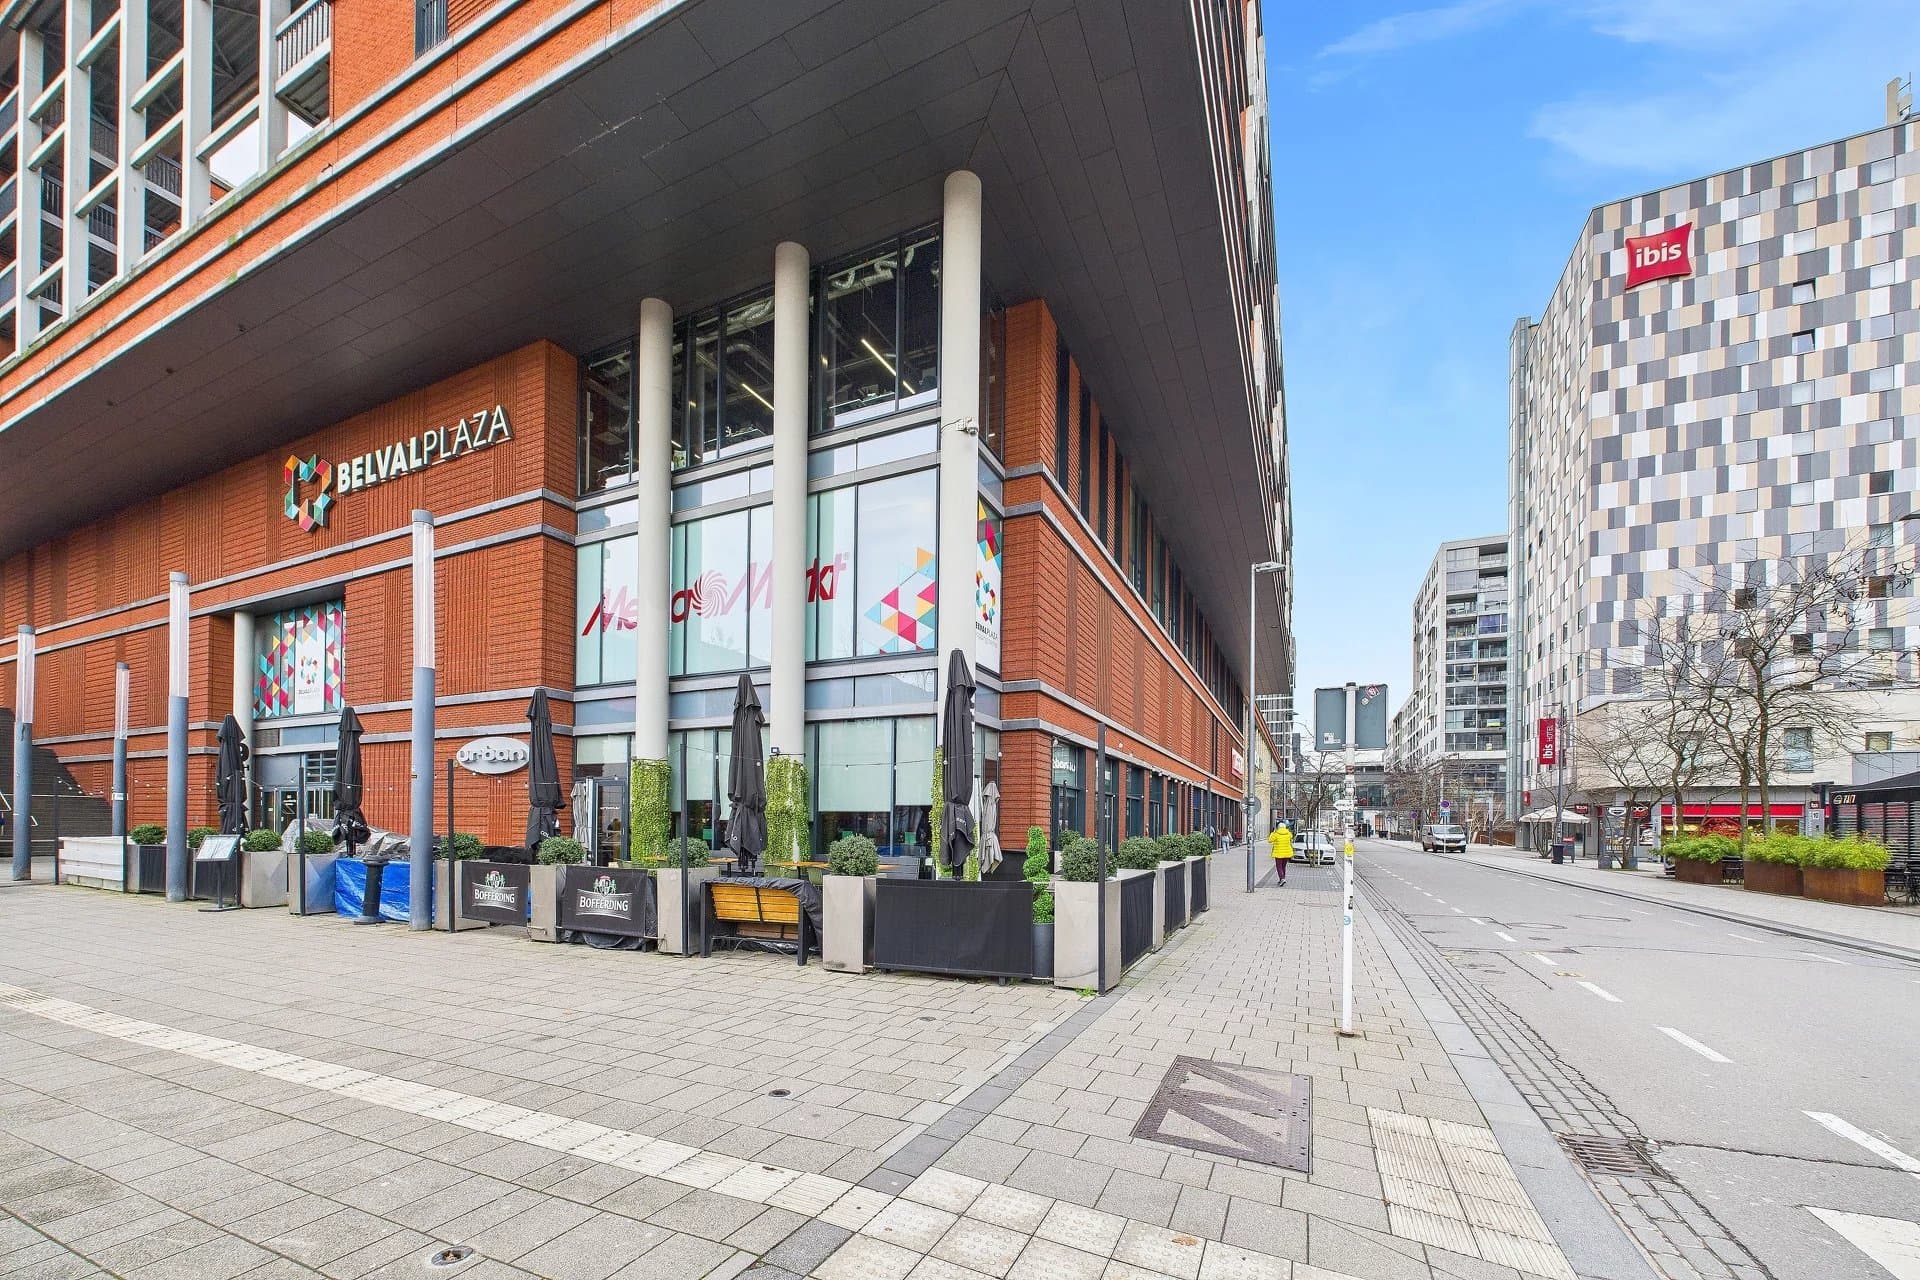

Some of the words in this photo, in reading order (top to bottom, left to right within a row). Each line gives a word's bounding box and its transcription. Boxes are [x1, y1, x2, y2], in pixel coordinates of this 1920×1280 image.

[1635, 242, 1682, 269] ibis
[458, 744, 526, 763] urban
[1542, 743, 1553, 759] ibis
[474, 888, 515, 904] BOFFERDING
[579, 896, 629, 912] BOFFERDING
